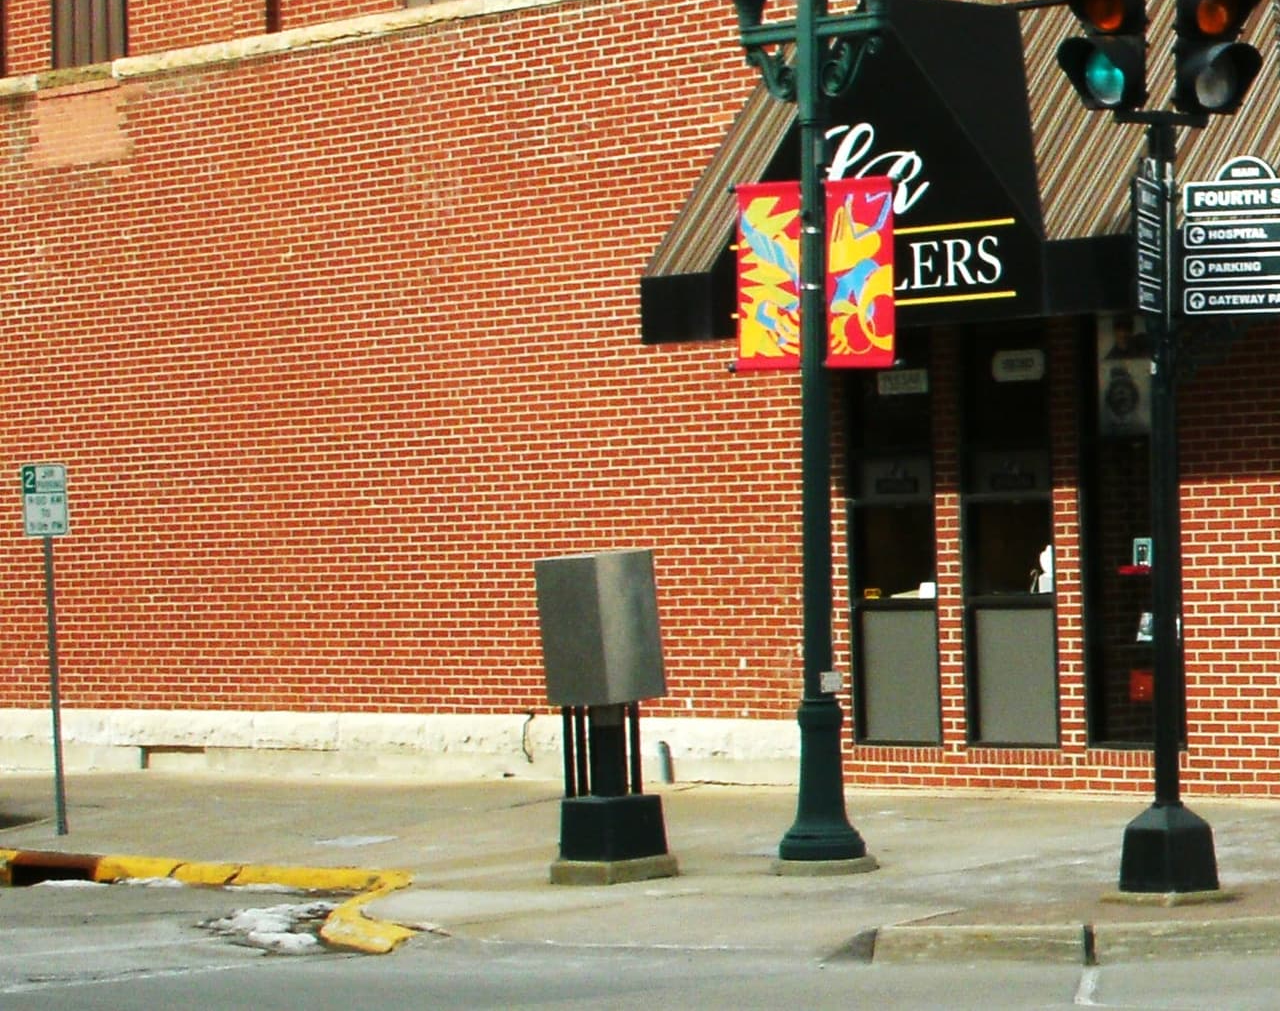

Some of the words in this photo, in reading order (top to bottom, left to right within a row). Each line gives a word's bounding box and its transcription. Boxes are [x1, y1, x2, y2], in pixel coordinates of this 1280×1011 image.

[1194, 190, 1266, 207] FOURTH
[1208, 228, 1268, 240] HOSPITAL
[1208, 261, 1262, 273] PARKING
[1208, 293, 1265, 306] GATEWAY
[25, 471, 35, 488] 2
